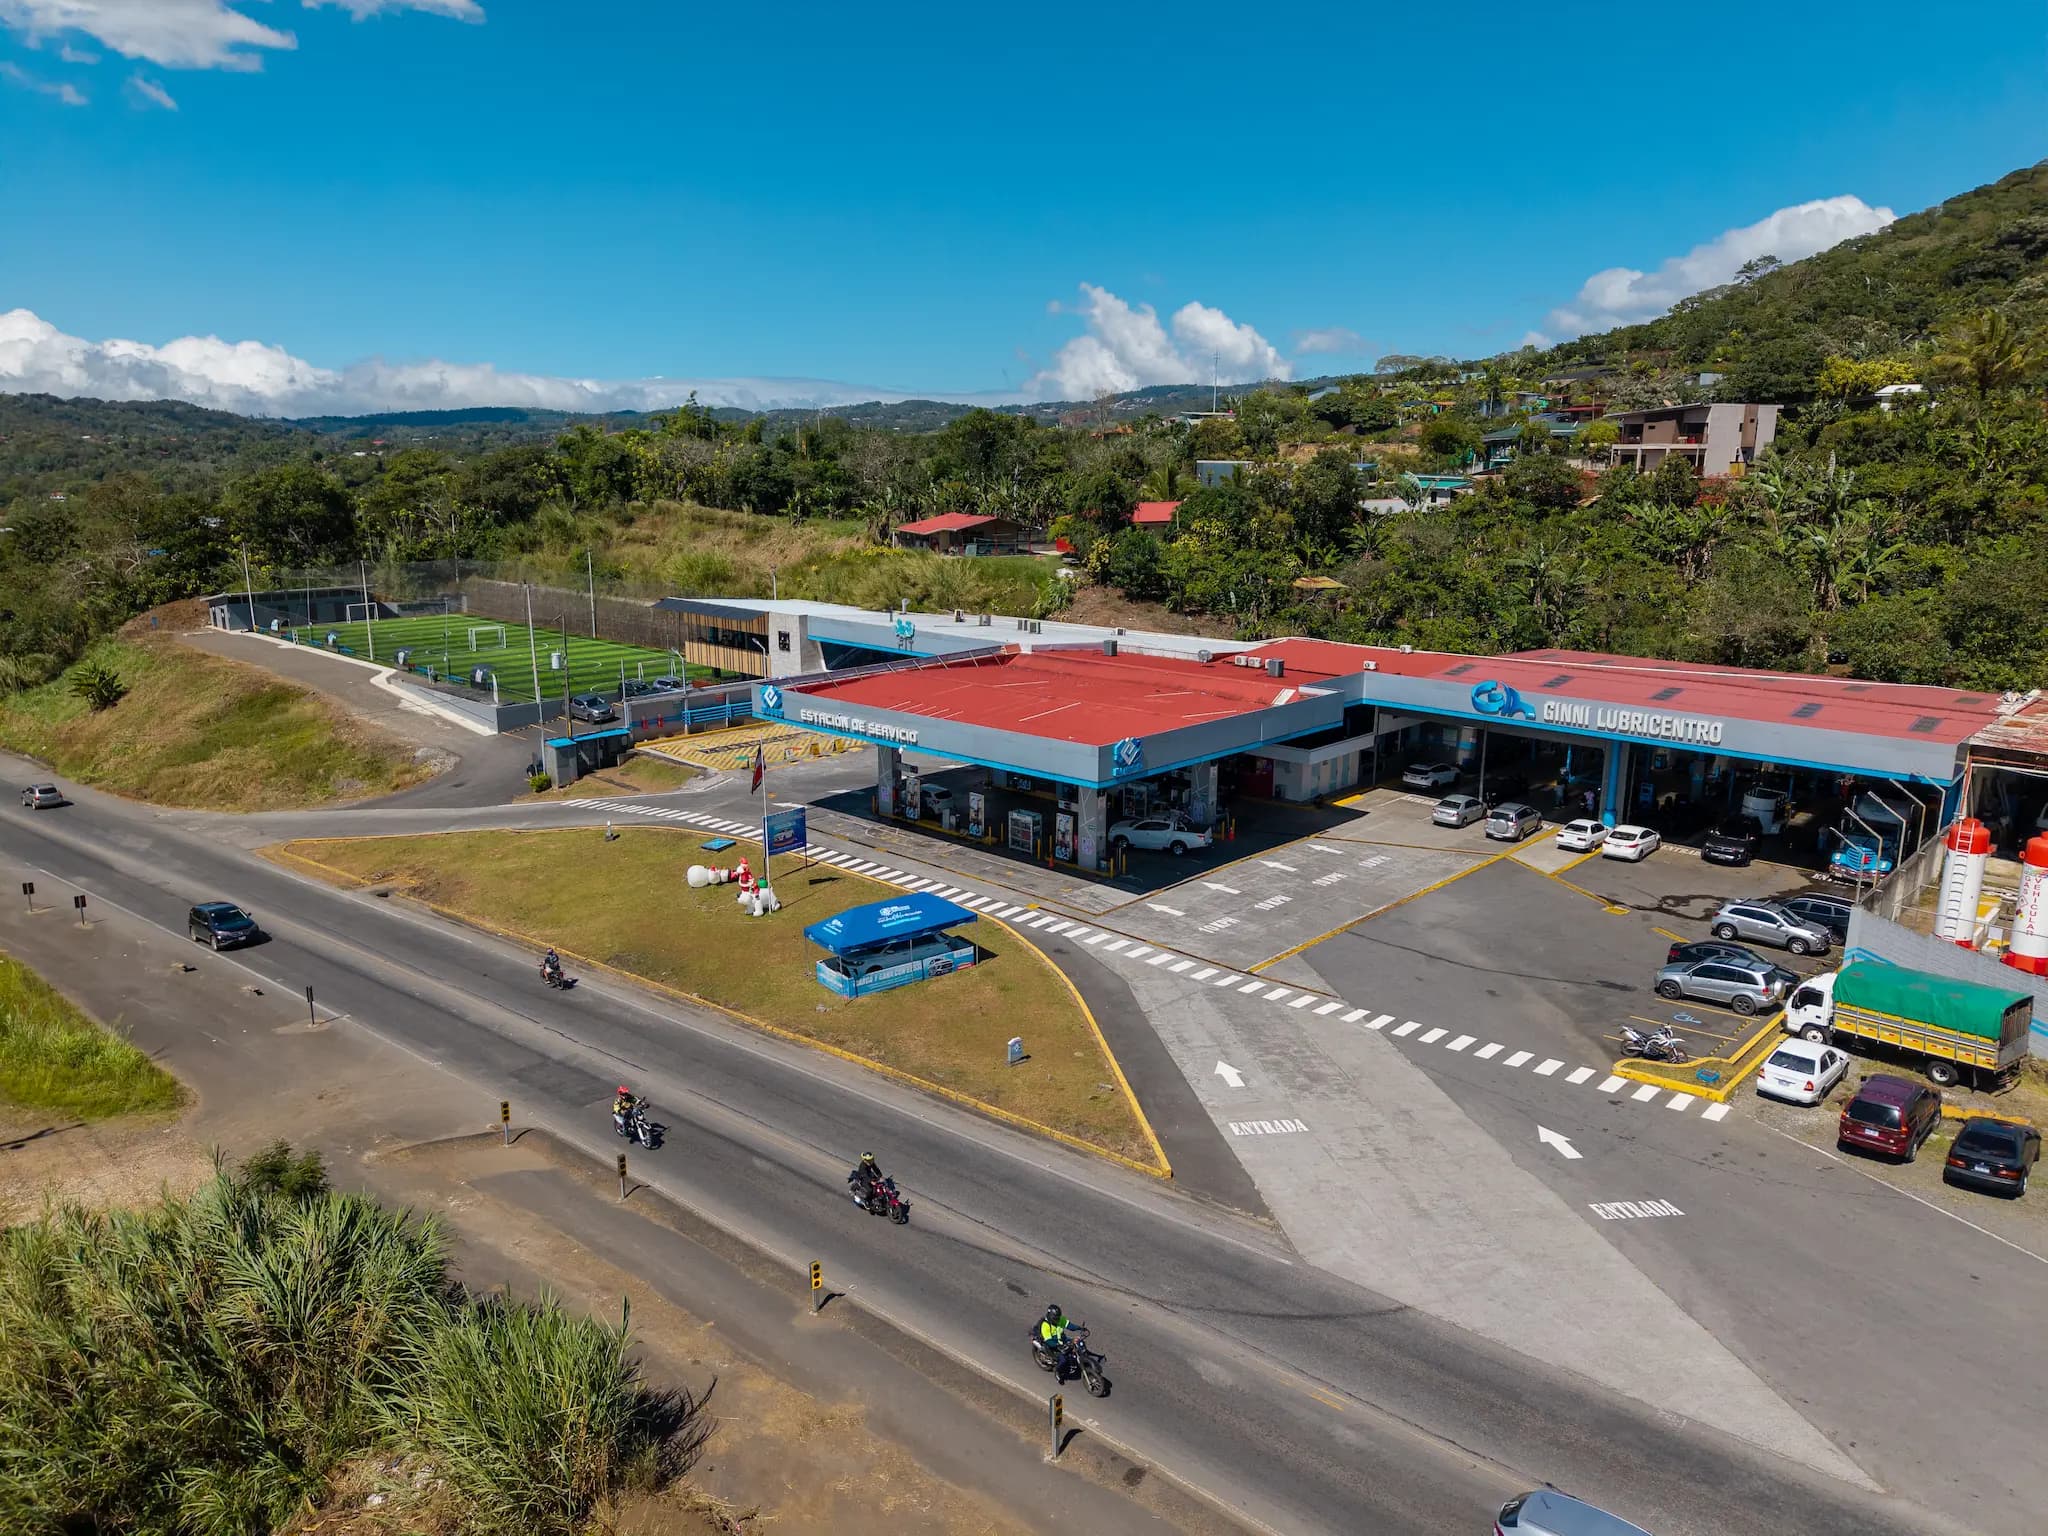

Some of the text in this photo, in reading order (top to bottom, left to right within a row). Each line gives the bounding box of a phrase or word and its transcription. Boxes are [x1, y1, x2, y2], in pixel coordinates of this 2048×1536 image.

[852, 718, 866, 732] DE
[867, 722, 919, 744] SERVICIO
[1543, 701, 1722, 745] GINNI LUBRICENTRO
[2025, 877, 2042, 936] VEHICULAR
[1228, 1119, 1310, 1136] ENTRADA
[1588, 1198, 1686, 1220] ENTRADA
